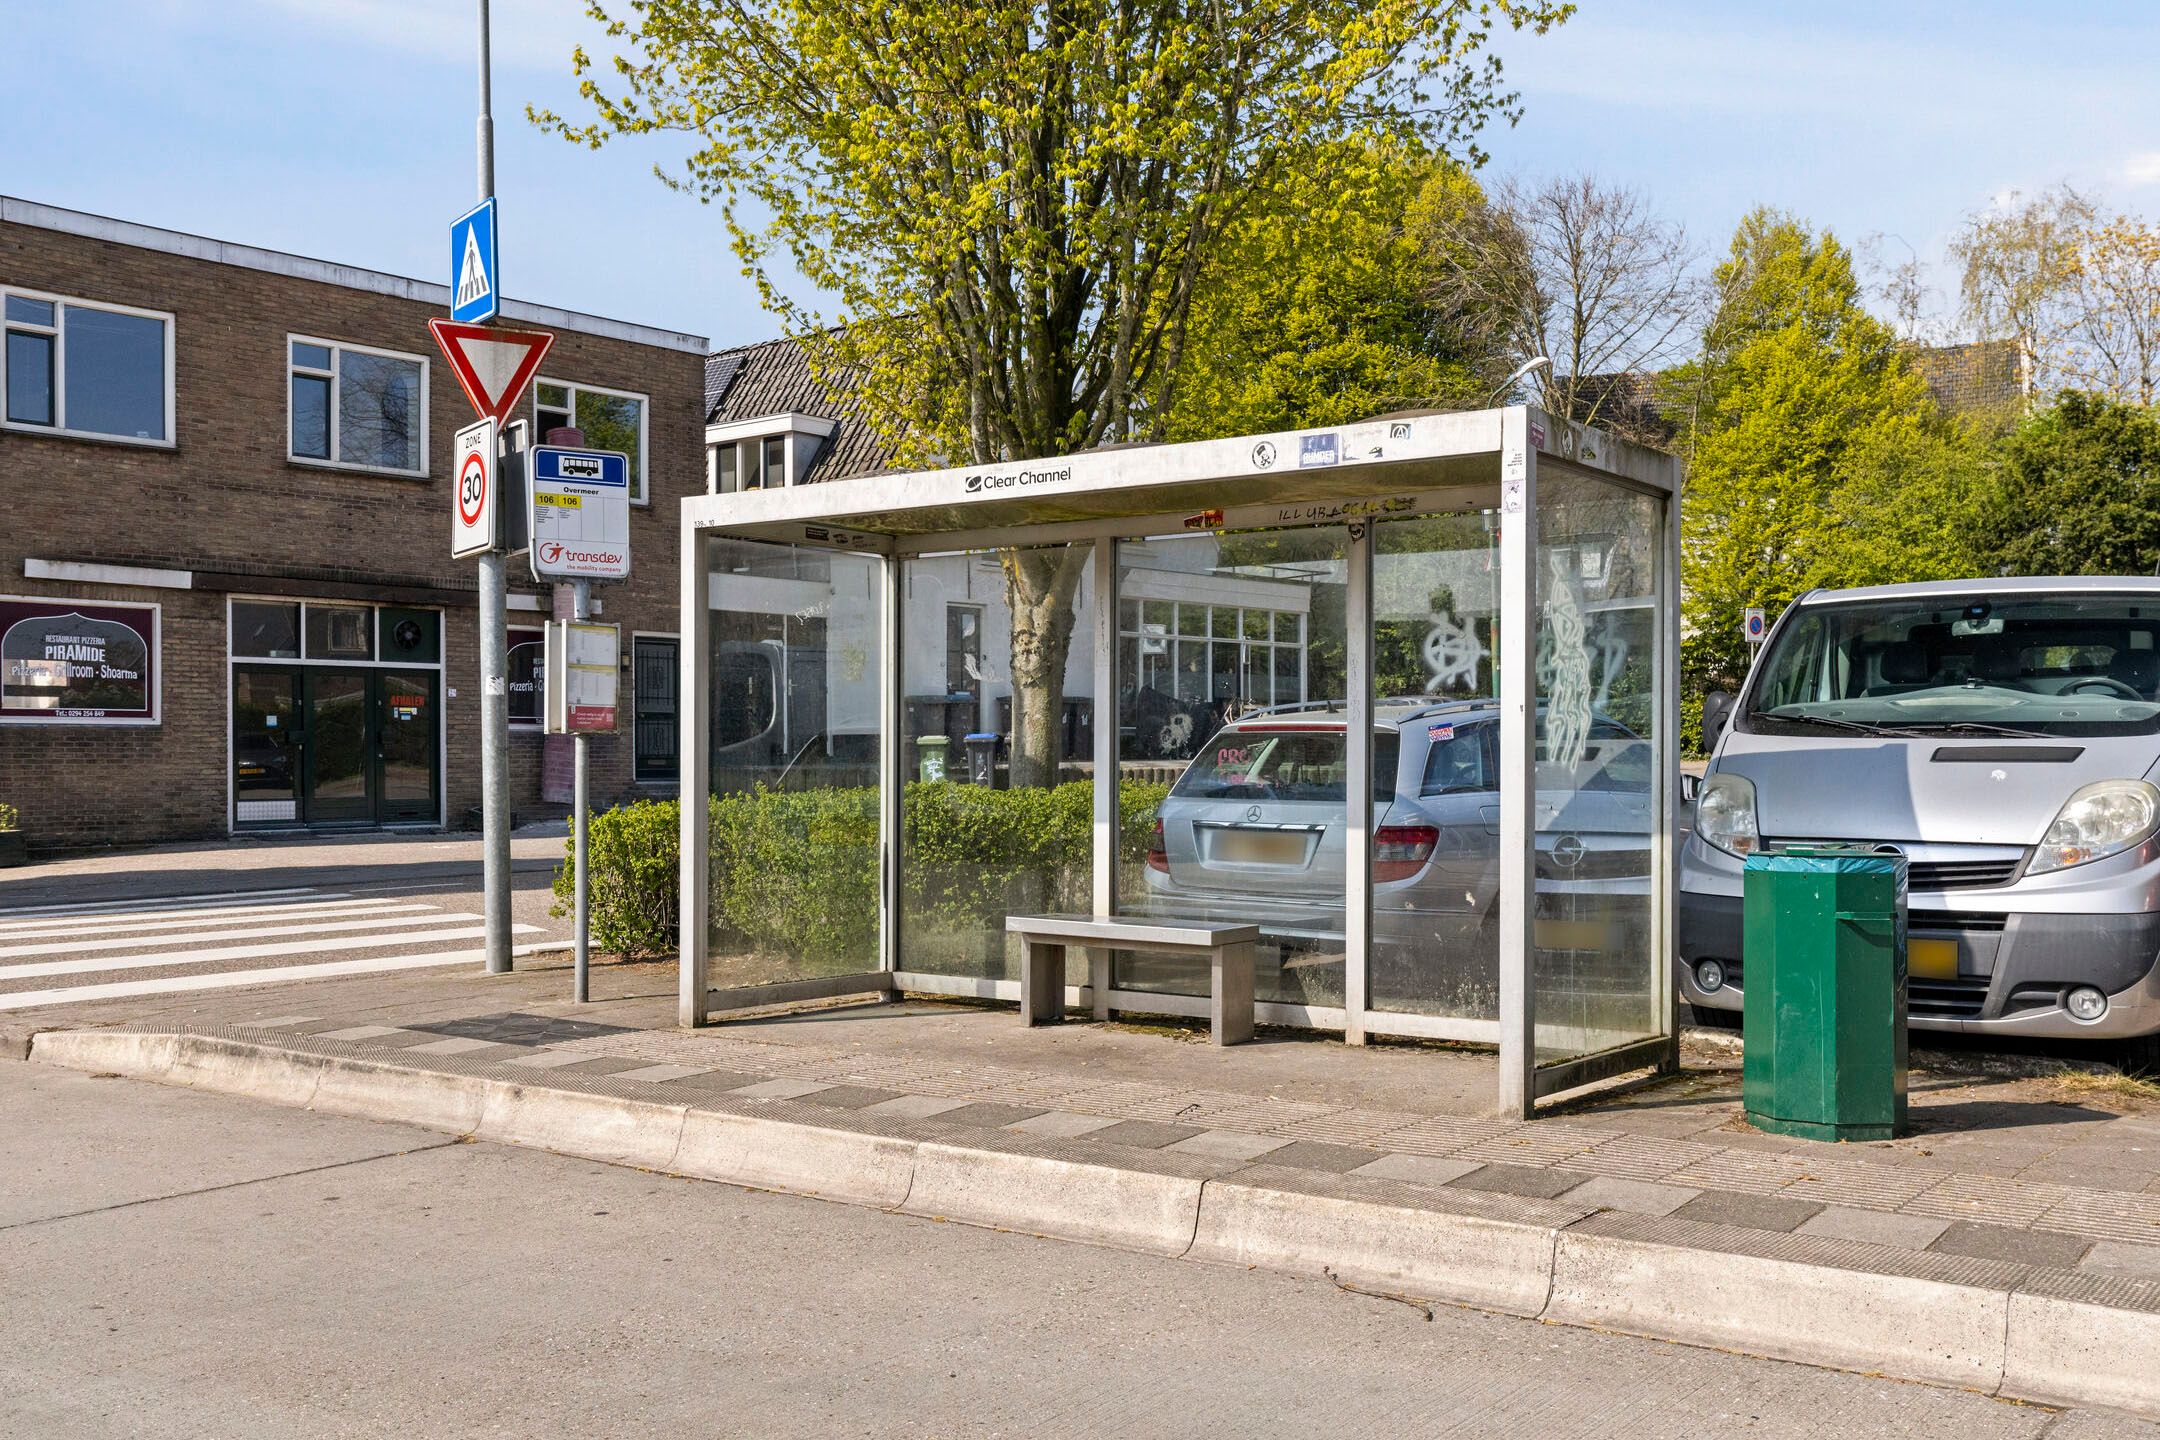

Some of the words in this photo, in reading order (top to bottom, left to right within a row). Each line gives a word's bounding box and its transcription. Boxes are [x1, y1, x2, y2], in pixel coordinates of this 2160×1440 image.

[466, 432, 481, 449] ZONE
[984, 475, 1017, 489] Clear
[1019, 466, 1071, 485] Channel
[463, 472, 482, 505] 30
[563, 486, 599, 495] Overmeer
[539, 495, 554, 504] 106
[563, 497, 577, 505] 106
[565, 549, 623, 564] transdev
[576, 564, 597, 572] mobility
[45, 634, 80, 644] RESTAURANT
[81, 636, 106, 645] PIZZERIA
[45, 645, 106, 662] PIRAMIDE
[100, 664, 138, 679] Shoarma
[509, 680, 534, 692] Pizzeria
